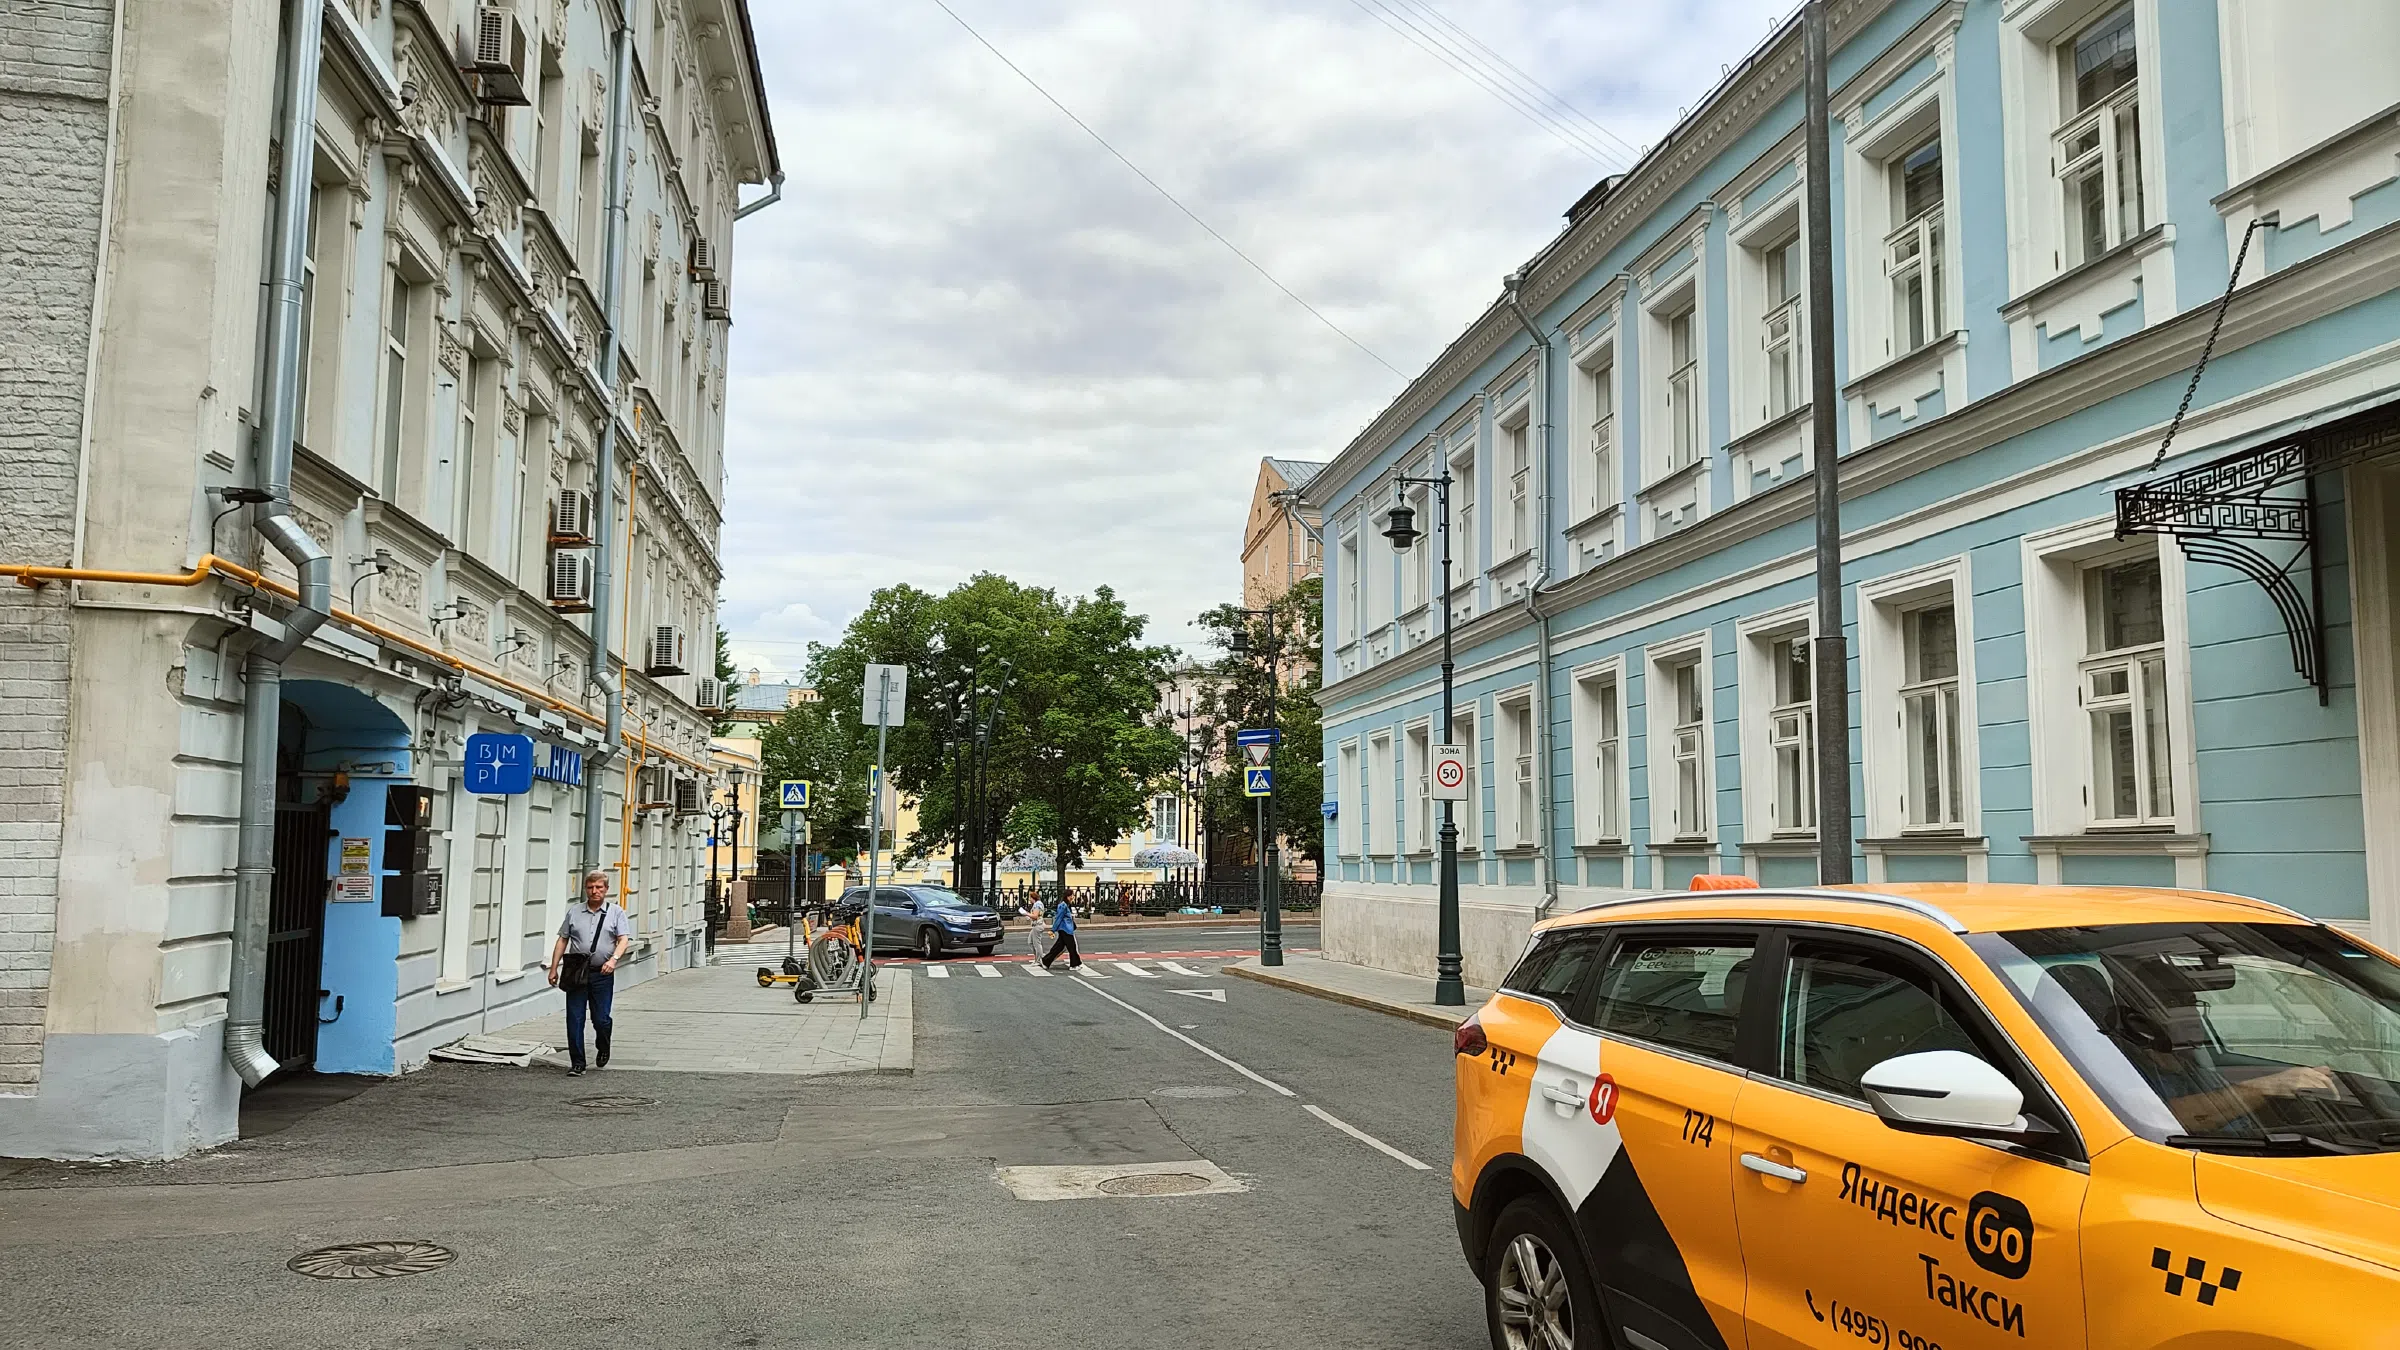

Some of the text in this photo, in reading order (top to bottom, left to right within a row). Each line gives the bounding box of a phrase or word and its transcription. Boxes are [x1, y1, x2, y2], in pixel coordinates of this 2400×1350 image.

[1439, 747, 1460, 755] ЗОНА
[1442, 768, 1458, 780] 50
[1594, 1083, 1612, 1116] Я
[1682, 1108, 1715, 1149] 174
[1838, 1161, 2024, 1264] Яндекс Go
[1918, 1252, 2026, 1338] Такси
[1831, 1300, 1890, 1350] (495)
